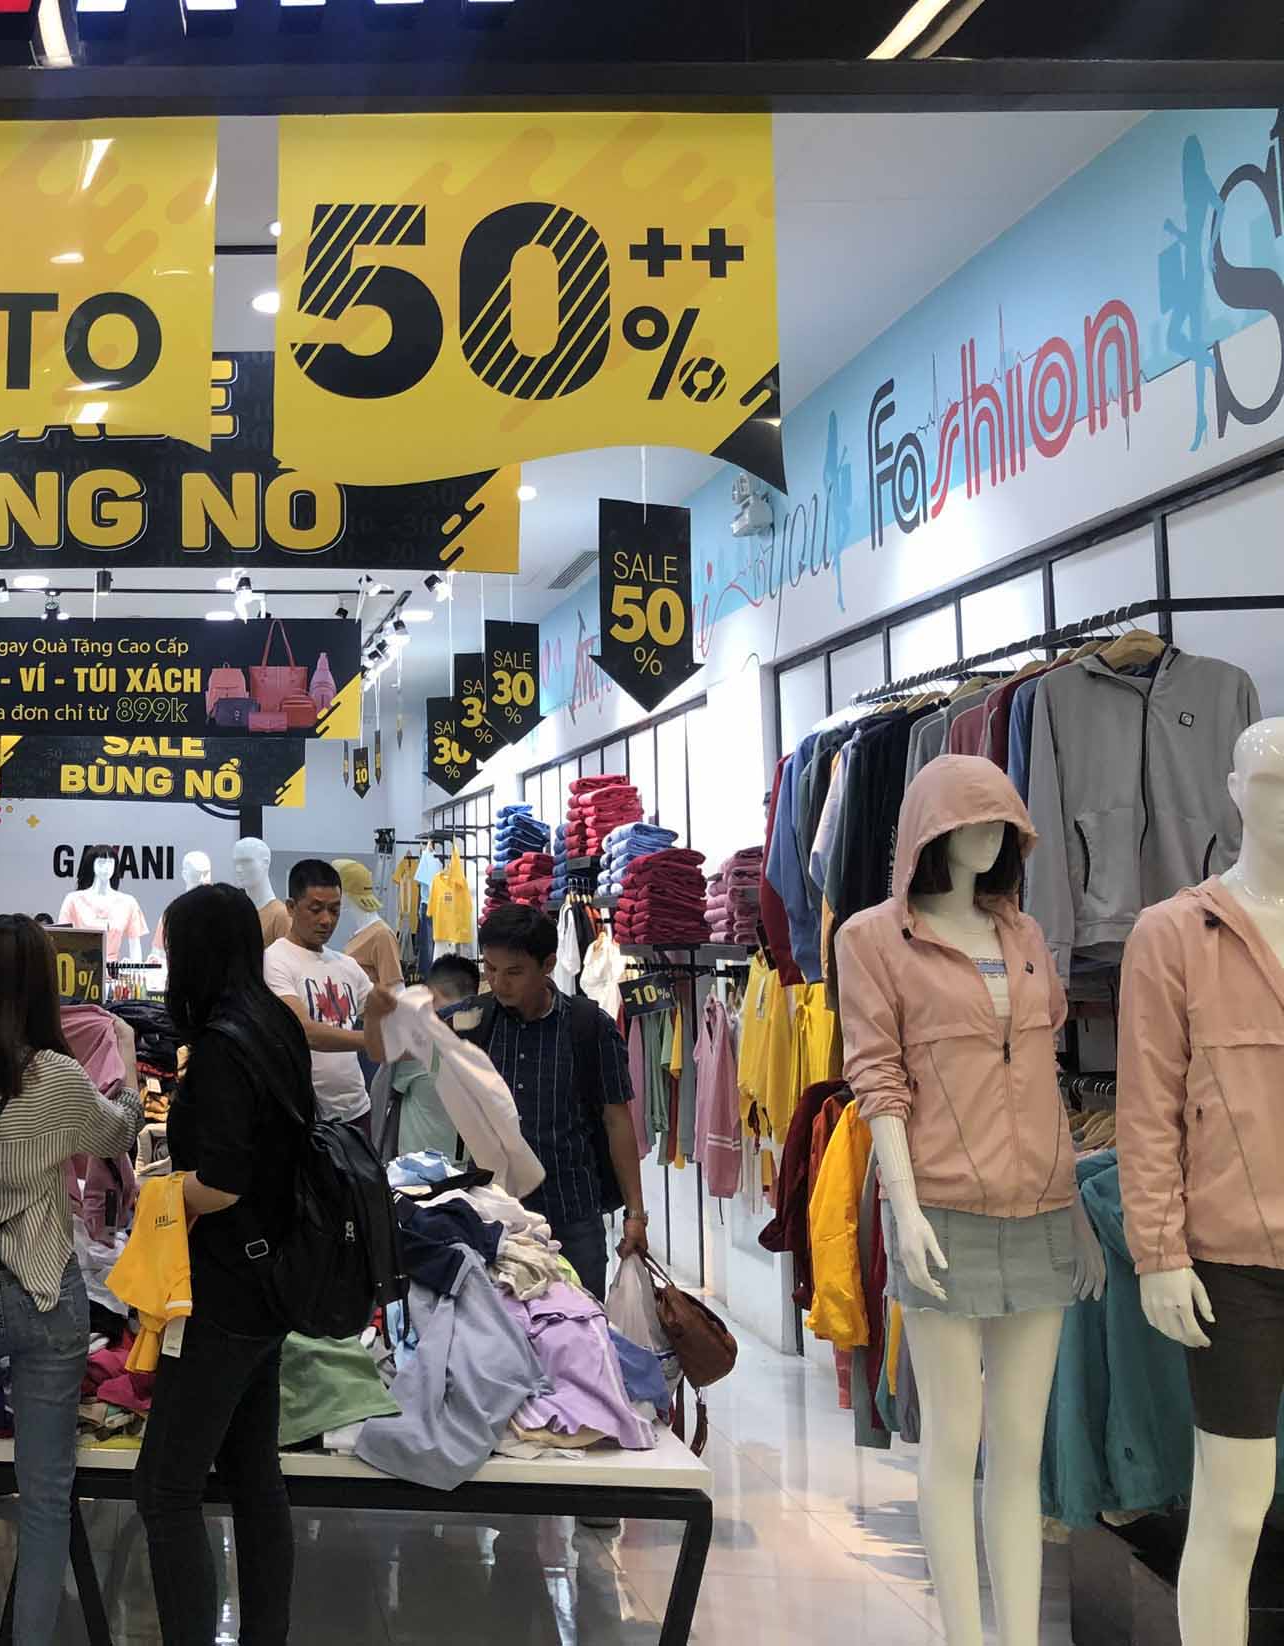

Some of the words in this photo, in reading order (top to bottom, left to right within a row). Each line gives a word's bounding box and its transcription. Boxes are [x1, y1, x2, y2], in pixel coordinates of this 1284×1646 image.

[289, 202, 612, 400] 50
[868, 299, 1142, 551] Fashion
[613, 551, 678, 585] SALE
[609, 585, 686, 647] 50
[32, 637, 68, 654] Quà
[70, 637, 113, 657] Tặng
[116, 638, 151, 654] Cao
[155, 636, 189, 657] Cấp
[493, 651, 533, 670] SALE
[633, 646, 664, 677] %
[19, 662, 46, 692] VÍ
[73, 662, 117, 693] TÚI
[125, 662, 203, 694] XÁCH
[462, 679, 485, 696] SA
[491, 670, 536, 707] 30
[11, 703, 49, 721] đơn
[54, 703, 84, 721] chỉ
[88, 705, 110, 721] từ
[116, 696, 189, 723] 899k
[504, 706, 523, 725] %
[103, 736, 205, 759] SALE
[60, 757, 174, 797] BÙNG
[183, 757, 244, 801] NỔ
